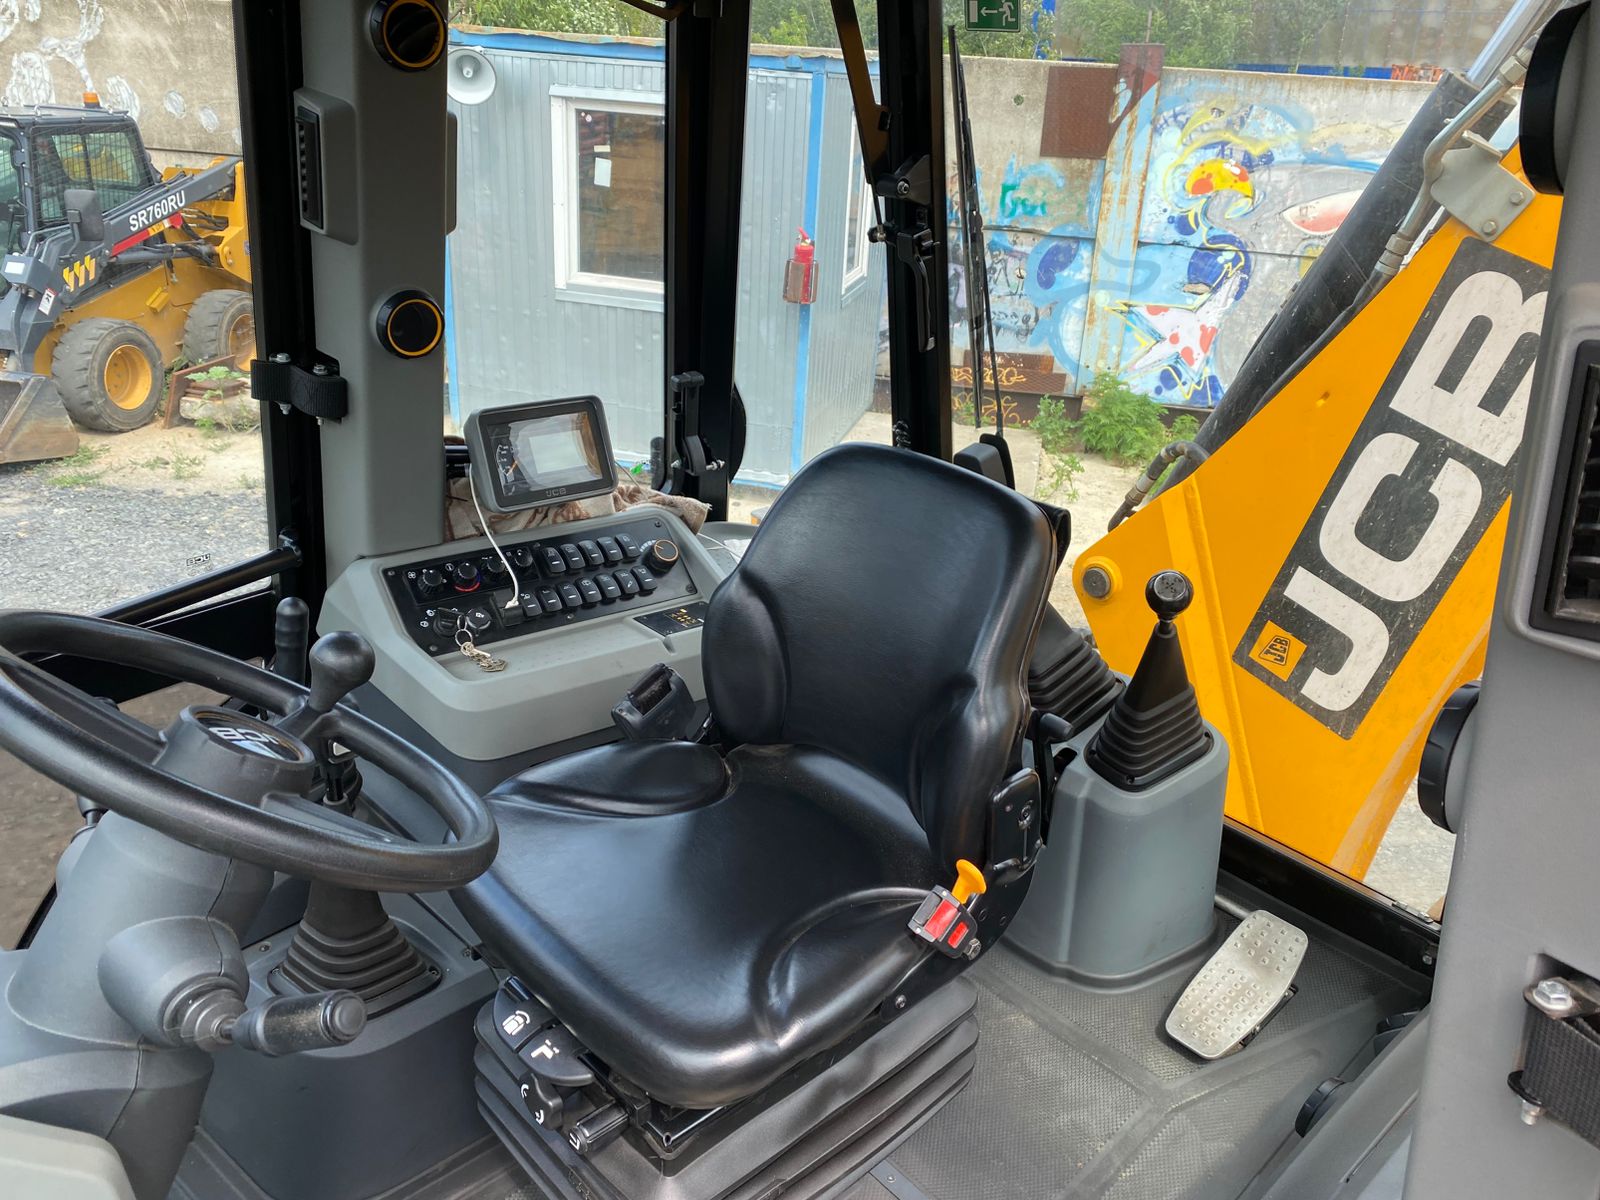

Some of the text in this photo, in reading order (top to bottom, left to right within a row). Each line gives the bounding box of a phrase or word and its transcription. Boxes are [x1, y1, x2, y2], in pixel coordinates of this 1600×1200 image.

[129, 190, 185, 231] SR760RU
[546, 488, 567, 497] JCB
[1283, 270, 1548, 712] JCB
[1263, 637, 1290, 664] JCB
